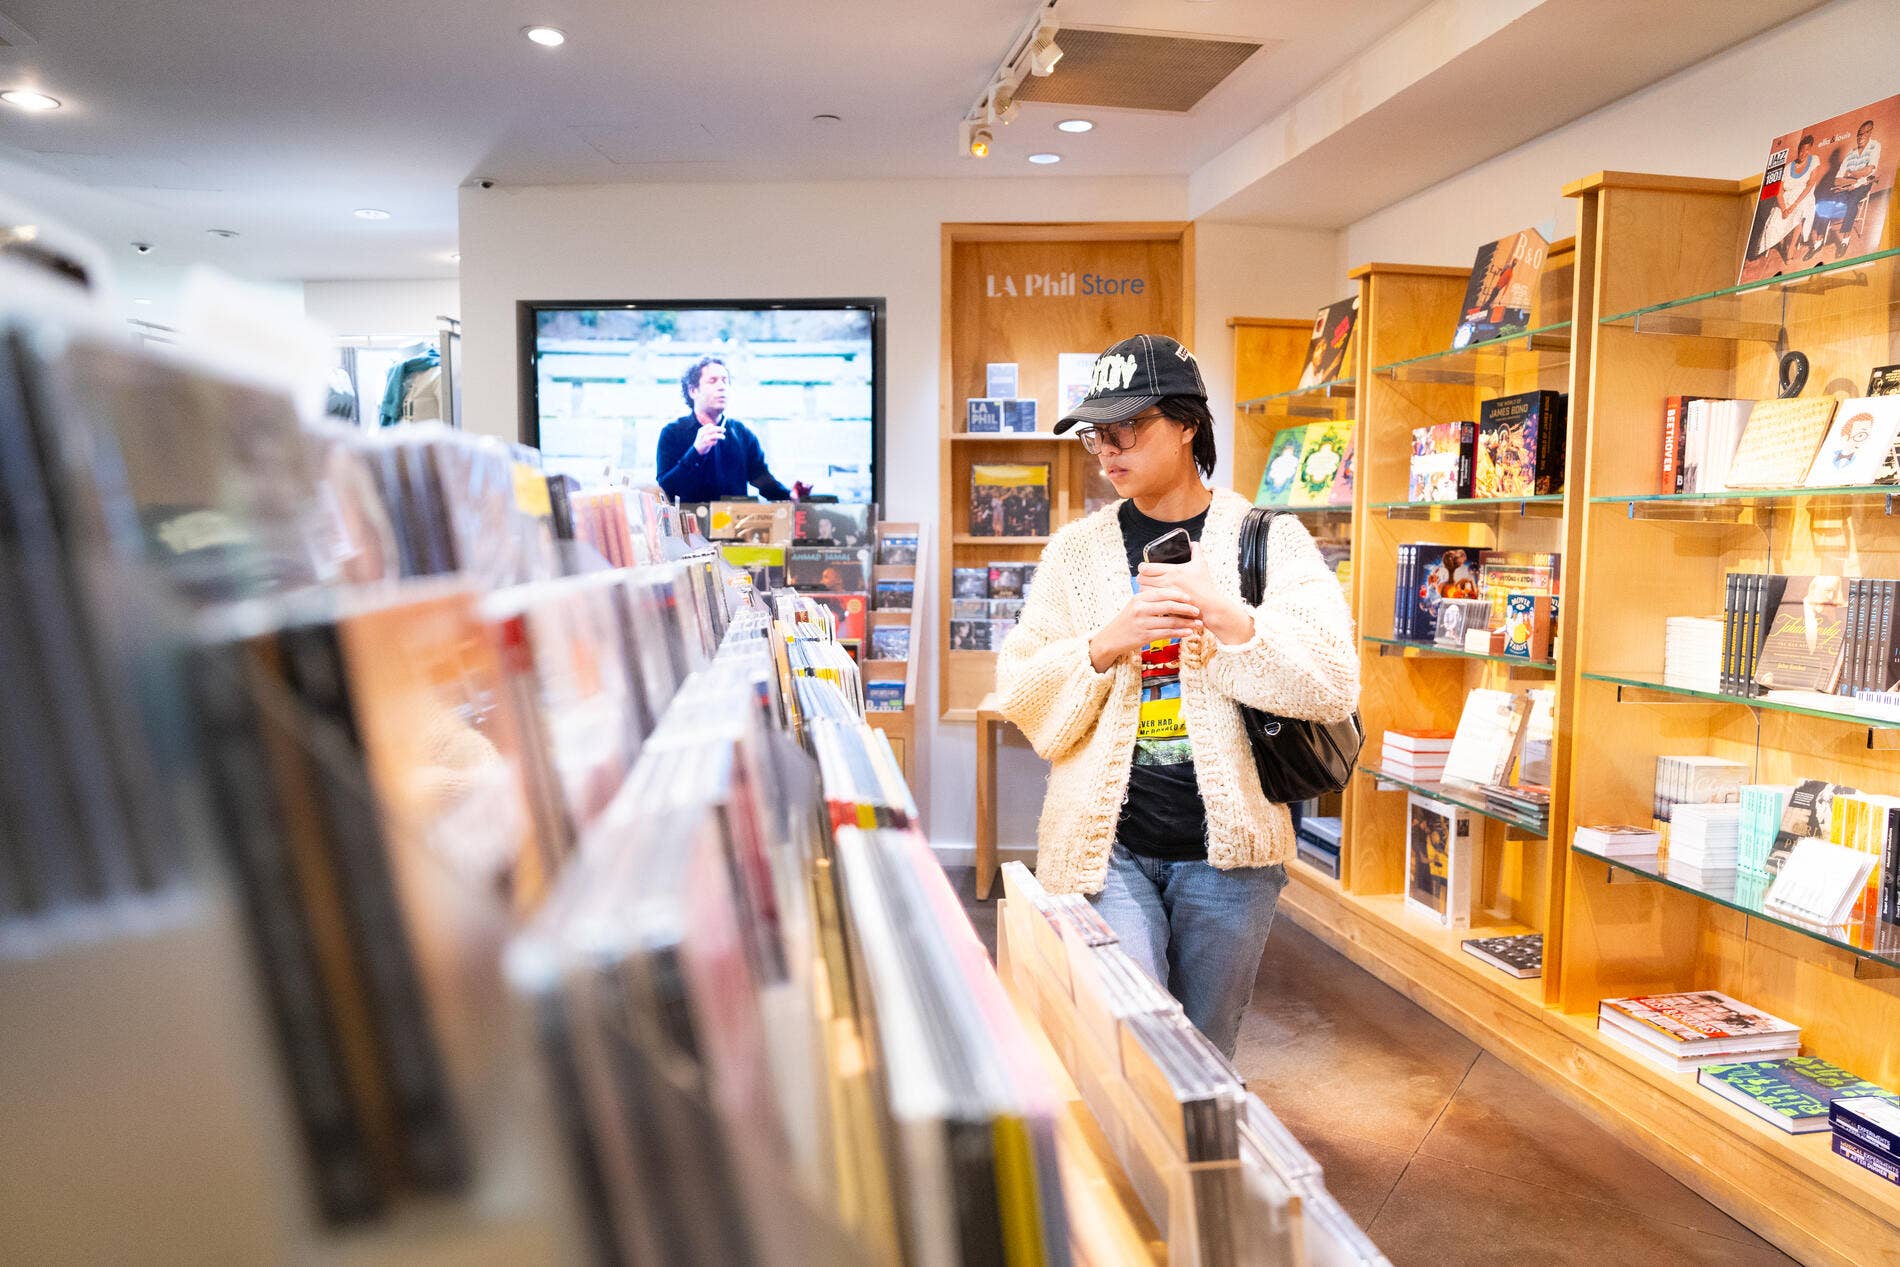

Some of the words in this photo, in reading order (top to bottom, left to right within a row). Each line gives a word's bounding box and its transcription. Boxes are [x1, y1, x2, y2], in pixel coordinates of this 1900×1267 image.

[1771, 150, 1787, 163] JAZZ
[986, 275, 1017, 297] LA
[1025, 272, 1075, 297] Phil
[1082, 273, 1145, 295] Store
[971, 403, 988, 413] LA
[1489, 407, 1510, 418] JAMES
[1511, 403, 1529, 414] BOND
[971, 413, 998, 424] PHIL
[1663, 409, 1676, 472] BEETHOVEN
[1860, 585, 1868, 604] JEAN
[1872, 585, 1880, 605] JEAN
[1884, 586, 1892, 606] JEAN
[1846, 606, 1854, 639] SIBELIUS
[1857, 606, 1866, 640] SIBELIUS
[1869, 607, 1878, 641] SIBELIUS
[1880, 608, 1890, 642] SIBELIUS
[1157, 718, 1173, 727] HAD
[1840, 1140, 1863, 1156] MUSICAL
[1863, 1149, 1899, 1174] EXPERIMENTS
